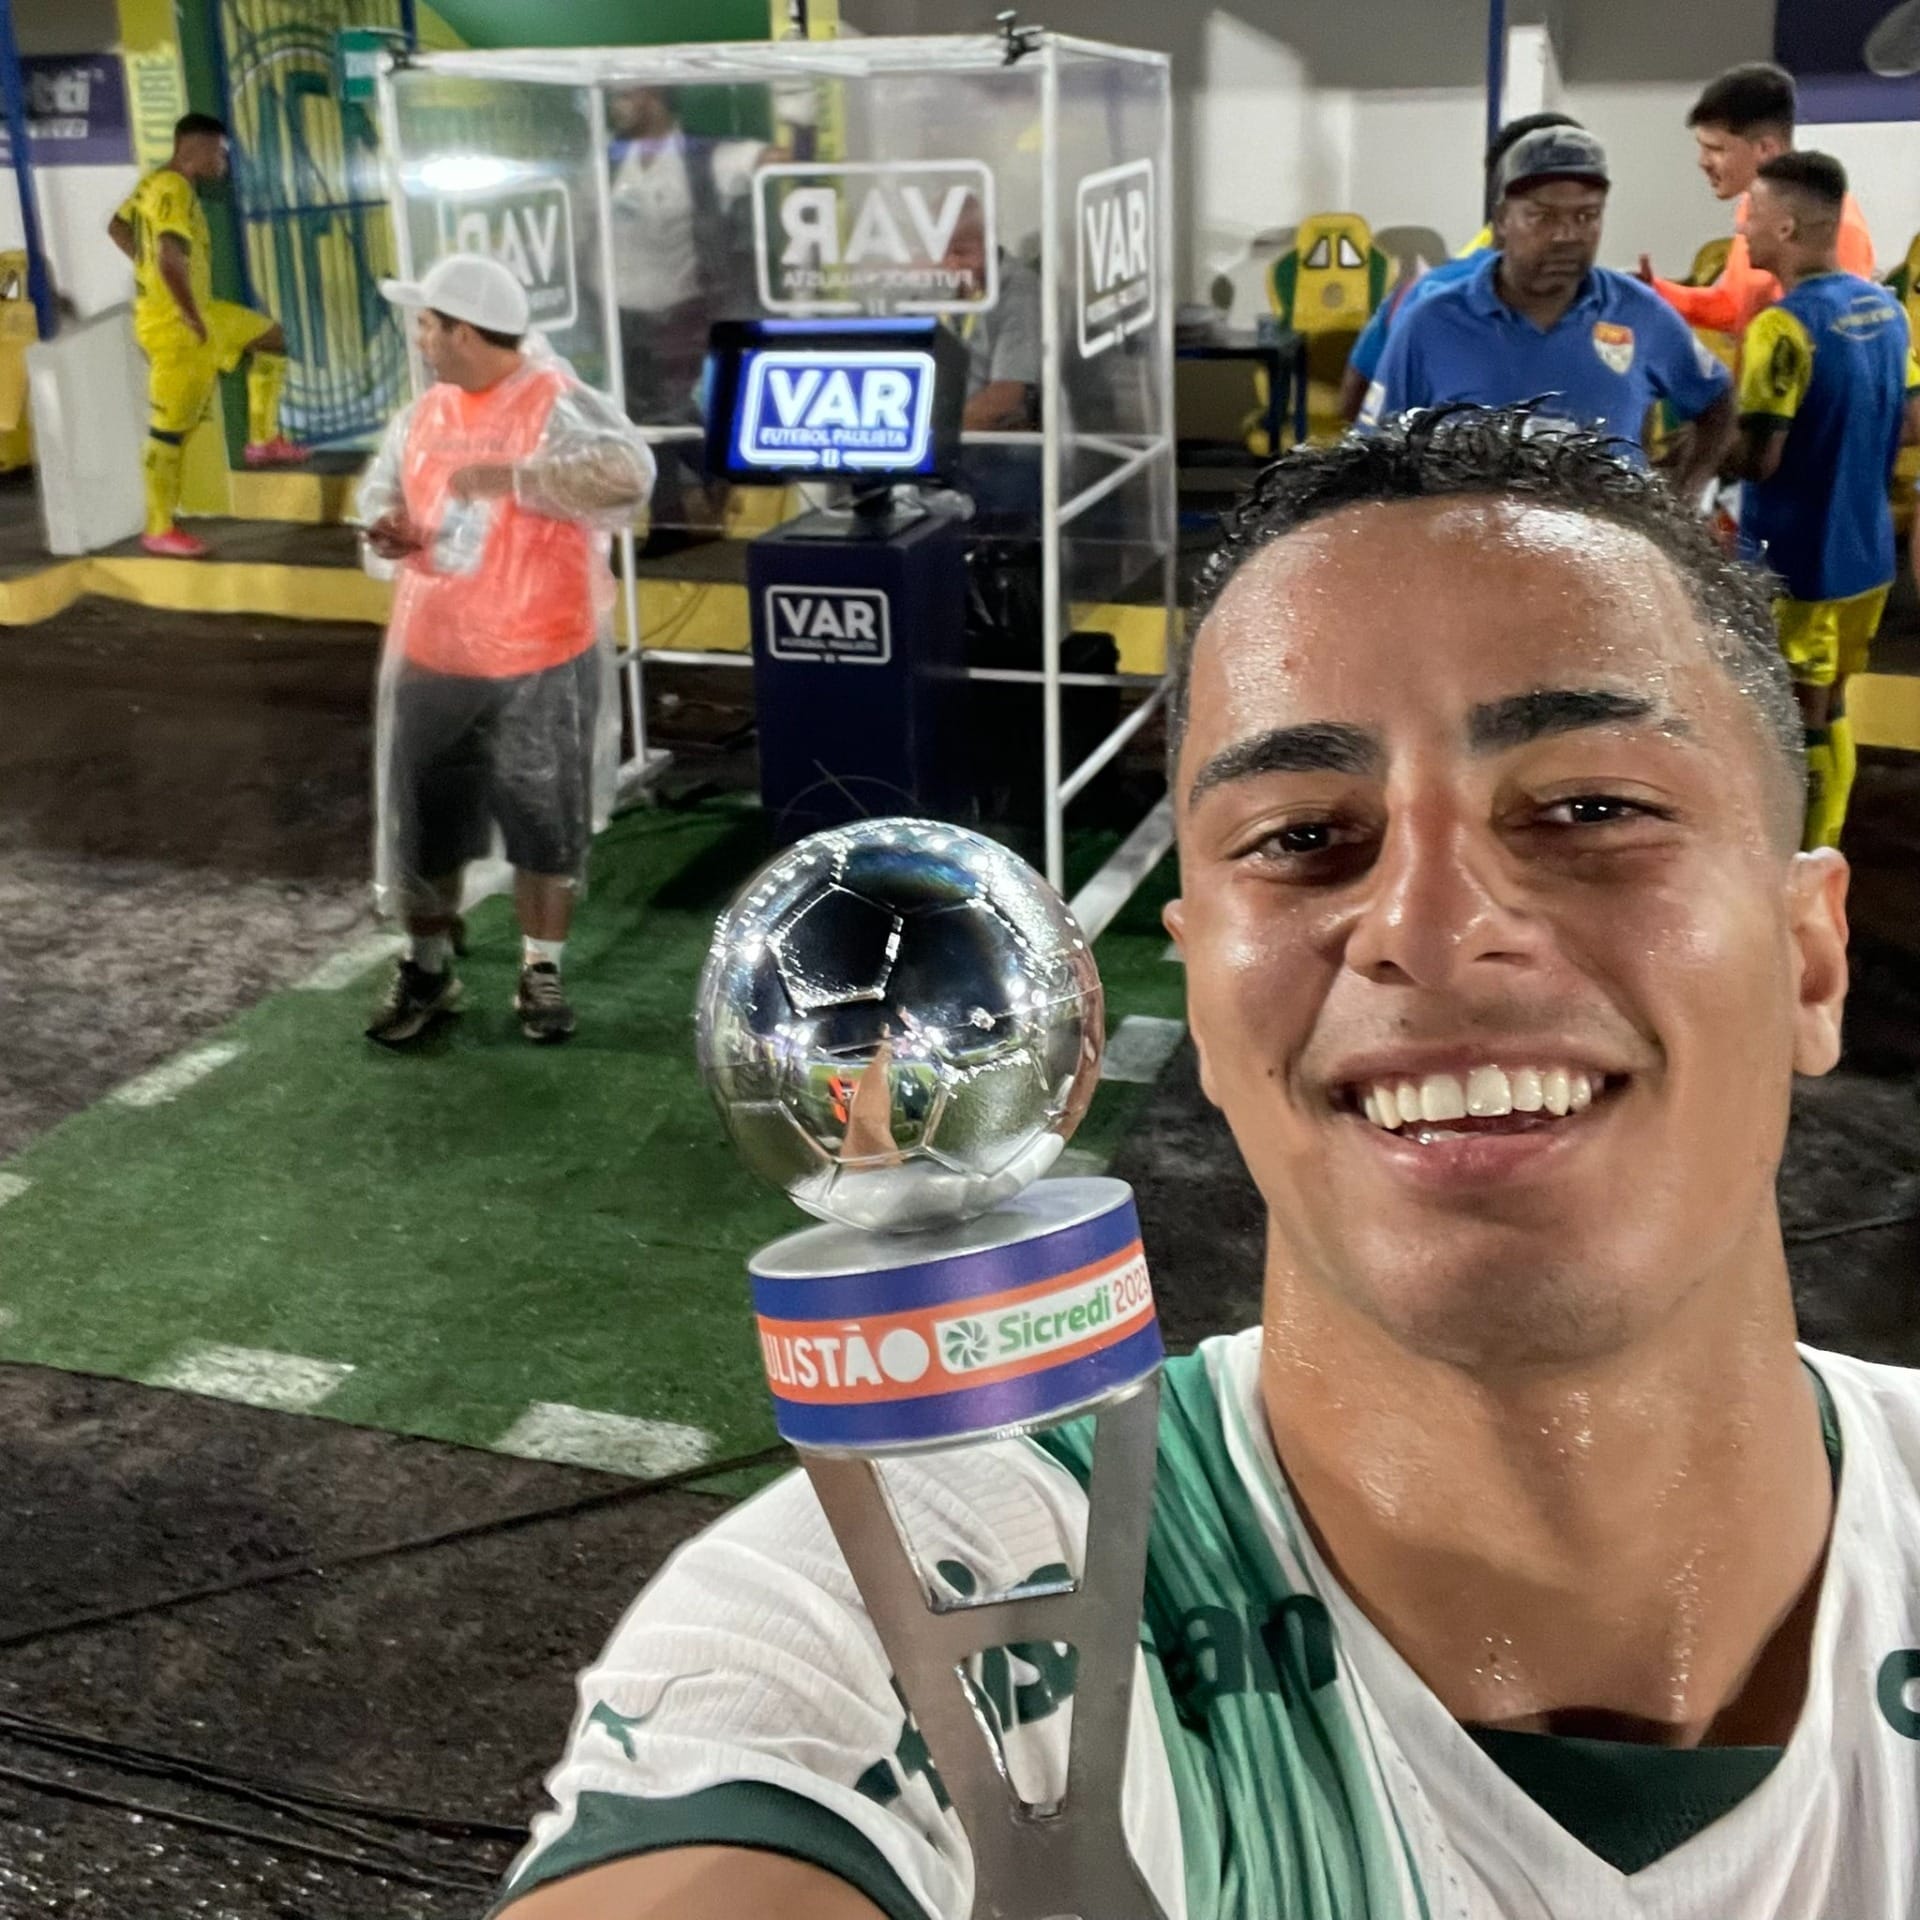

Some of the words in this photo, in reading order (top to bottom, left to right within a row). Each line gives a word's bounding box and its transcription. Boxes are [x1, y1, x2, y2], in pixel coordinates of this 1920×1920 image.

[1086, 190, 1146, 293] VAR
[768, 369, 912, 428] VAR
[760, 427, 830, 446] FUTEBOL
[833, 429, 907, 447] PAULISTA
[779, 597, 877, 639] VAR
[999, 1284, 1111, 1354] Sicredi
